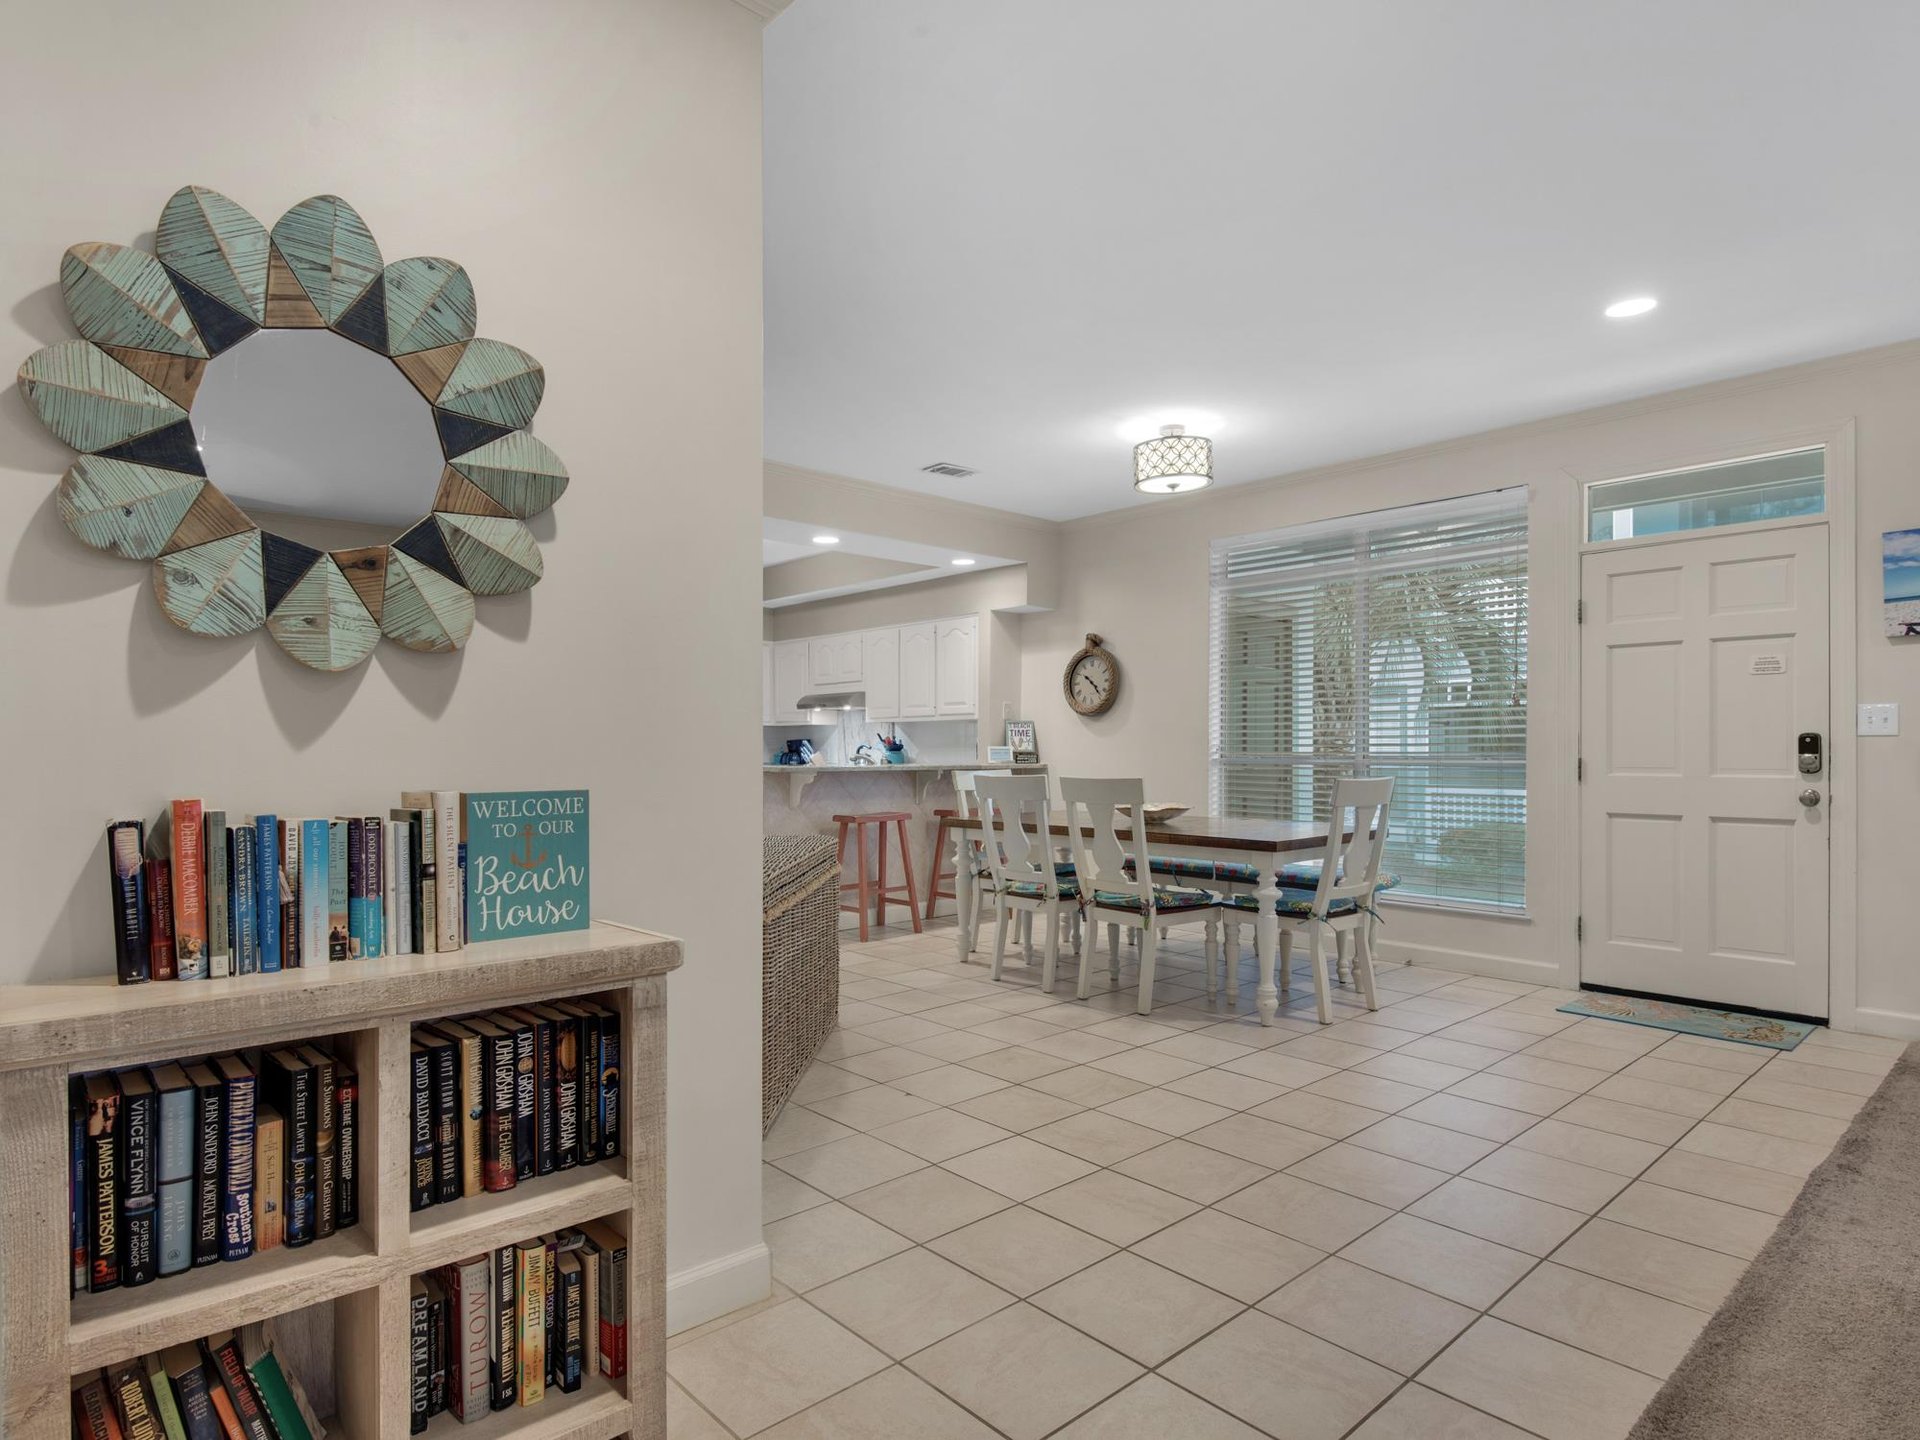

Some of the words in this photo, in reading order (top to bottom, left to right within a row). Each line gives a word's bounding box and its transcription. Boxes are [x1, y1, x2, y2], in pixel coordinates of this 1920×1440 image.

[1010, 729, 1031, 737] TIME
[446, 807, 454, 822] THE
[472, 797, 585, 819] WELCOME
[182, 823, 196, 856] DEBBIE
[263, 823, 273, 846] JAMES
[287, 827, 297, 850] DAVID
[312, 836, 320, 846] all
[368, 833, 376, 853] JODI
[446, 824, 455, 853] SILENT
[491, 822, 518, 838] TO
[538, 820, 575, 835] OUR
[238, 829, 246, 873] SANDRA
[288, 855, 297, 871] JOY
[329, 832, 338, 871] PICOULT
[338, 841, 346, 860] JODI
[264, 848, 273, 891] PATTERSON
[368, 855, 377, 890] PICOULT
[447, 856, 455, 889] PATIENT
[474, 854, 585, 896] Beach
[123, 880, 137, 903] JOHN
[183, 858, 198, 916] MACOMBER
[238, 874, 247, 912] BROWN
[331, 888, 345, 897] The
[477, 895, 581, 932] House
[242, 917, 251, 956] TAILSPIN
[469, 1036, 482, 1063] JOHN
[495, 1039, 513, 1066] JOHN
[518, 1031, 534, 1058] JOHN
[542, 1028, 550, 1047] THE
[323, 1067, 332, 1084] THE
[415, 1055, 430, 1089] DAVID
[440, 1050, 453, 1077] SCOTT
[542, 1048, 550, 1082] APPEAL
[296, 1072, 308, 1090] THE
[441, 1079, 454, 1108] TUROW
[469, 1064, 482, 1105] GRISHAM
[495, 1065, 514, 1111] GRISHAM
[518, 1072, 534, 1118] GRISHAM
[560, 1081, 577, 1107] JOHN
[204, 1095, 219, 1122] JOHN
[229, 1080, 255, 1132] PATRICIA
[296, 1092, 307, 1120] STREET
[323, 1085, 333, 1128] SUMMONS
[341, 1088, 352, 1126] EXTREME
[542, 1086, 551, 1110] JOHN
[130, 1099, 145, 1146] VINCE
[416, 1092, 430, 1142] BALDACCI
[498, 1113, 512, 1132] THE
[542, 1111, 551, 1152] GRISHAM
[560, 1106, 577, 1150] GRISHAM
[204, 1123, 218, 1174] SANDFORD
[296, 1122, 307, 1152] LAWYER
[499, 1132, 512, 1173] CHAMBER
[97, 1137, 114, 1178] JAMES
[228, 1131, 254, 1194] CORNWELL
[321, 1155, 333, 1179] JOHN
[341, 1127, 352, 1179] OWNERSHIP
[441, 1146, 455, 1180] ERRORS
[130, 1149, 145, 1196] FLYNN
[291, 1157, 305, 1184] JOHN
[415, 1158, 426, 1188] JUSTICE
[425, 1158, 433, 1184] DIVINE
[202, 1179, 217, 1215] MORTAL
[294, 1185, 305, 1228] GRISHAM
[323, 1180, 333, 1220] GRISHAM
[98, 1180, 115, 1256] PATTERSON
[130, 1220, 140, 1234] OF
[163, 1194, 173, 1241] IRVING
[175, 1199, 185, 1232] JOHN
[201, 1217, 216, 1241] PREY
[225, 1211, 240, 1243] Cross
[130, 1236, 140, 1267] HONOR
[140, 1220, 150, 1263] PURSUIT
[502, 1248, 513, 1274] SCOTT
[527, 1254, 541, 1285] JIMMY
[546, 1250, 555, 1274] RICH
[502, 1274, 514, 1302] TUROW
[546, 1275, 555, 1294] DAD
[567, 1284, 580, 1307] JAMES
[527, 1289, 541, 1328] BUFFETT
[546, 1294, 555, 1313] POOR
[567, 1308, 580, 1321] LEE
[501, 1306, 515, 1352] PLEADING
[546, 1313, 555, 1328] DAD
[567, 1321, 580, 1344] BURKE
[414, 1296, 429, 1413] DREAMLAND
[468, 1291, 488, 1396] TUROW
[219, 1347, 240, 1376] FIELD
[501, 1352, 514, 1384] GUILTY
[231, 1373, 246, 1389] OF
[119, 1380, 148, 1422] ROBERT
[236, 1387, 258, 1419] VALOR
